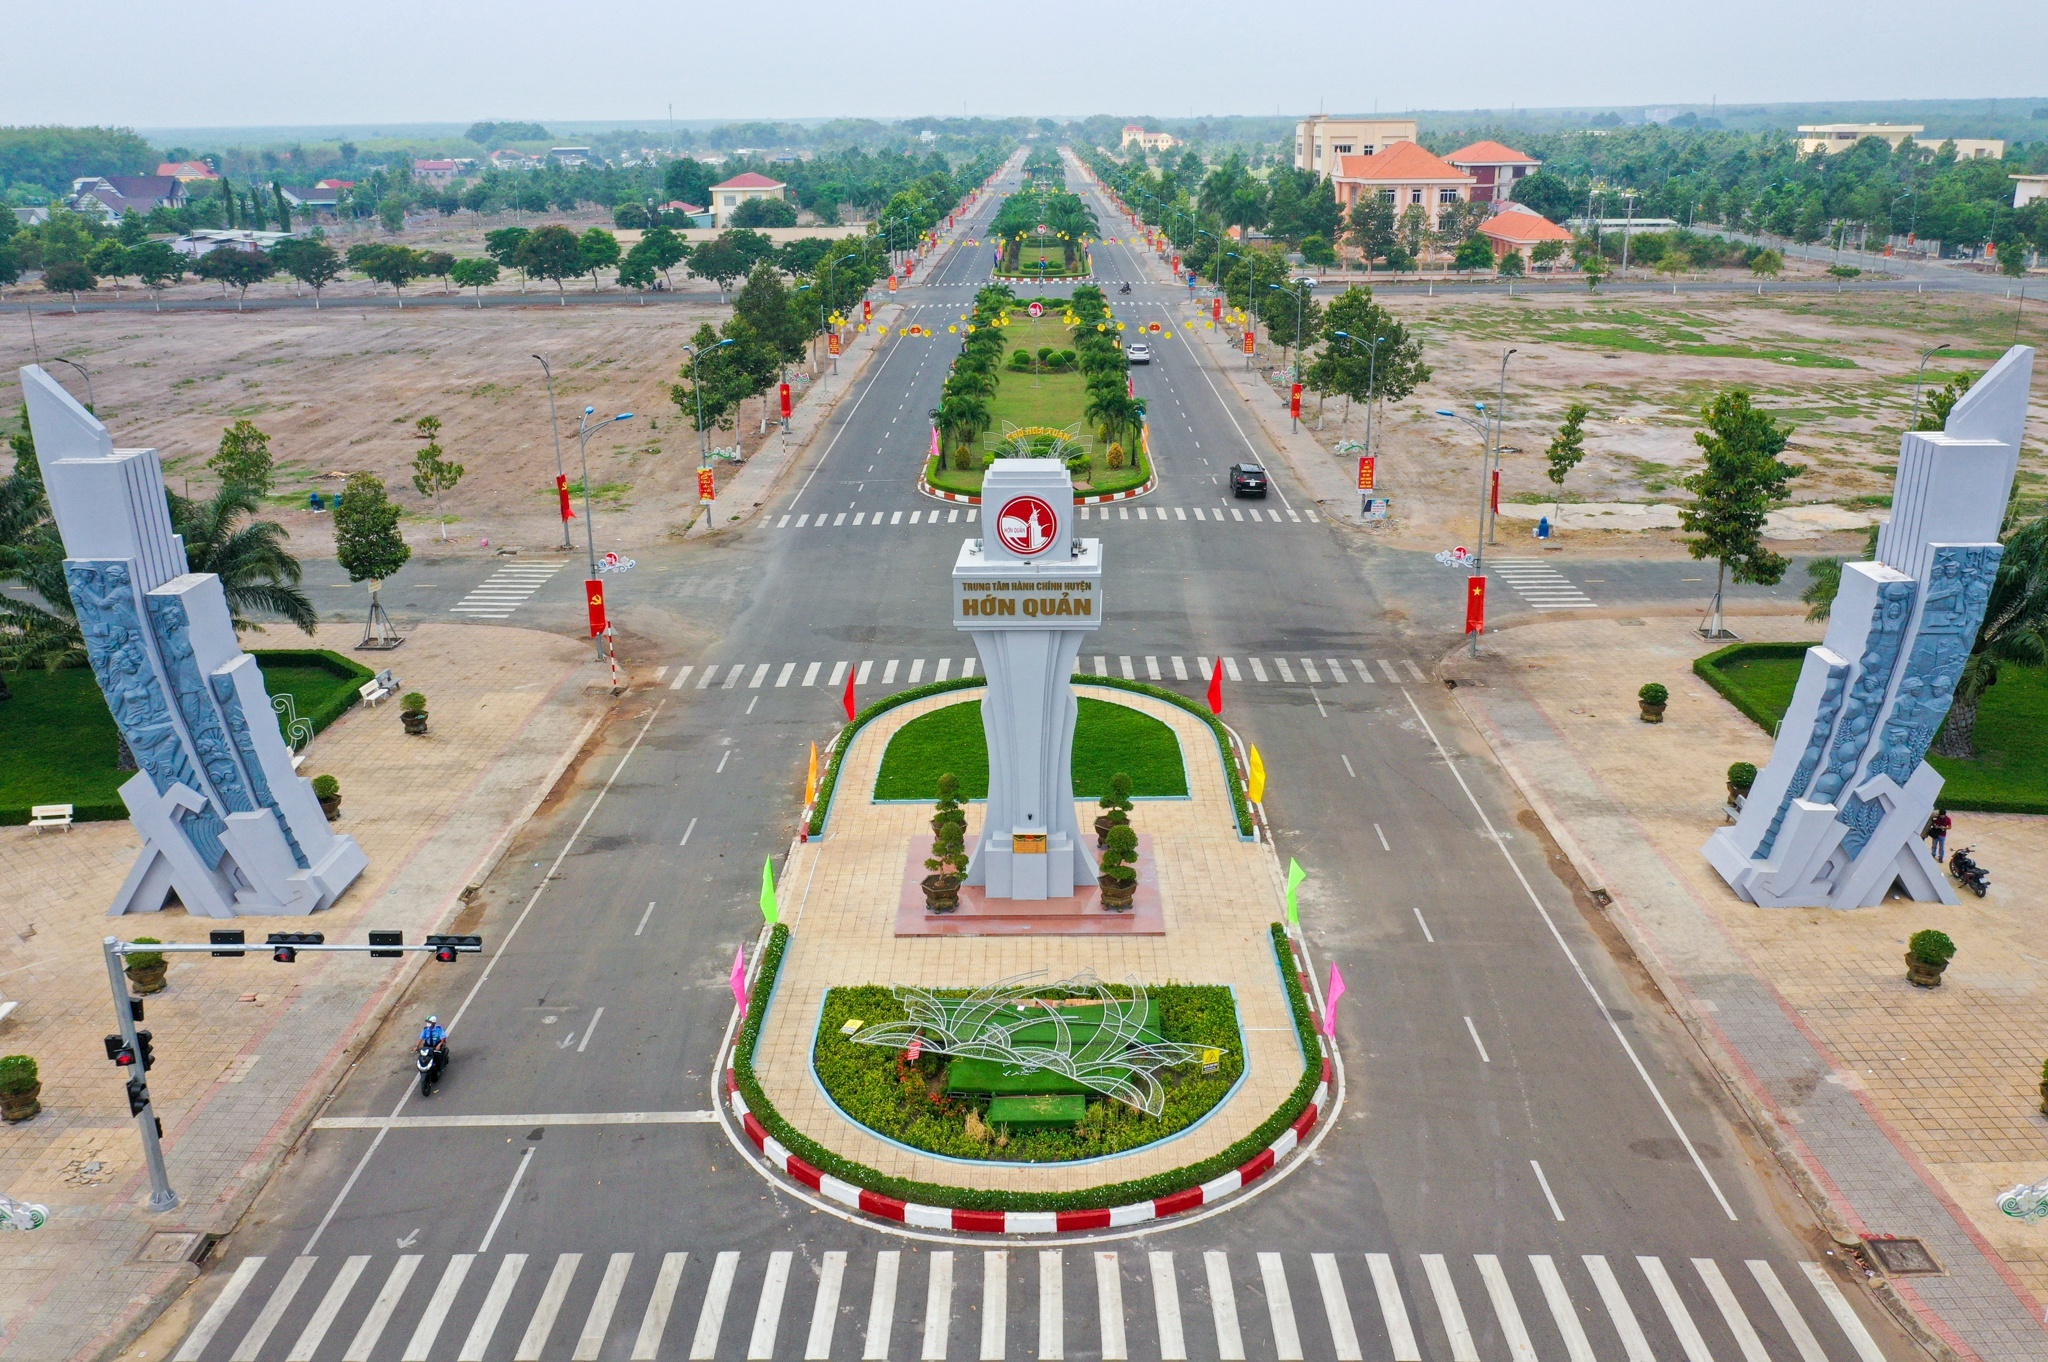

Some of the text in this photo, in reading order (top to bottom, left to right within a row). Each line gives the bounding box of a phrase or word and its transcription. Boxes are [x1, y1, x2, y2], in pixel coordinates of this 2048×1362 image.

[962, 580, 1092, 592] TRUNG TÂM HÀNH CHÍNH HUYỆN
[962, 591, 1092, 618] HỚN QUẢN
